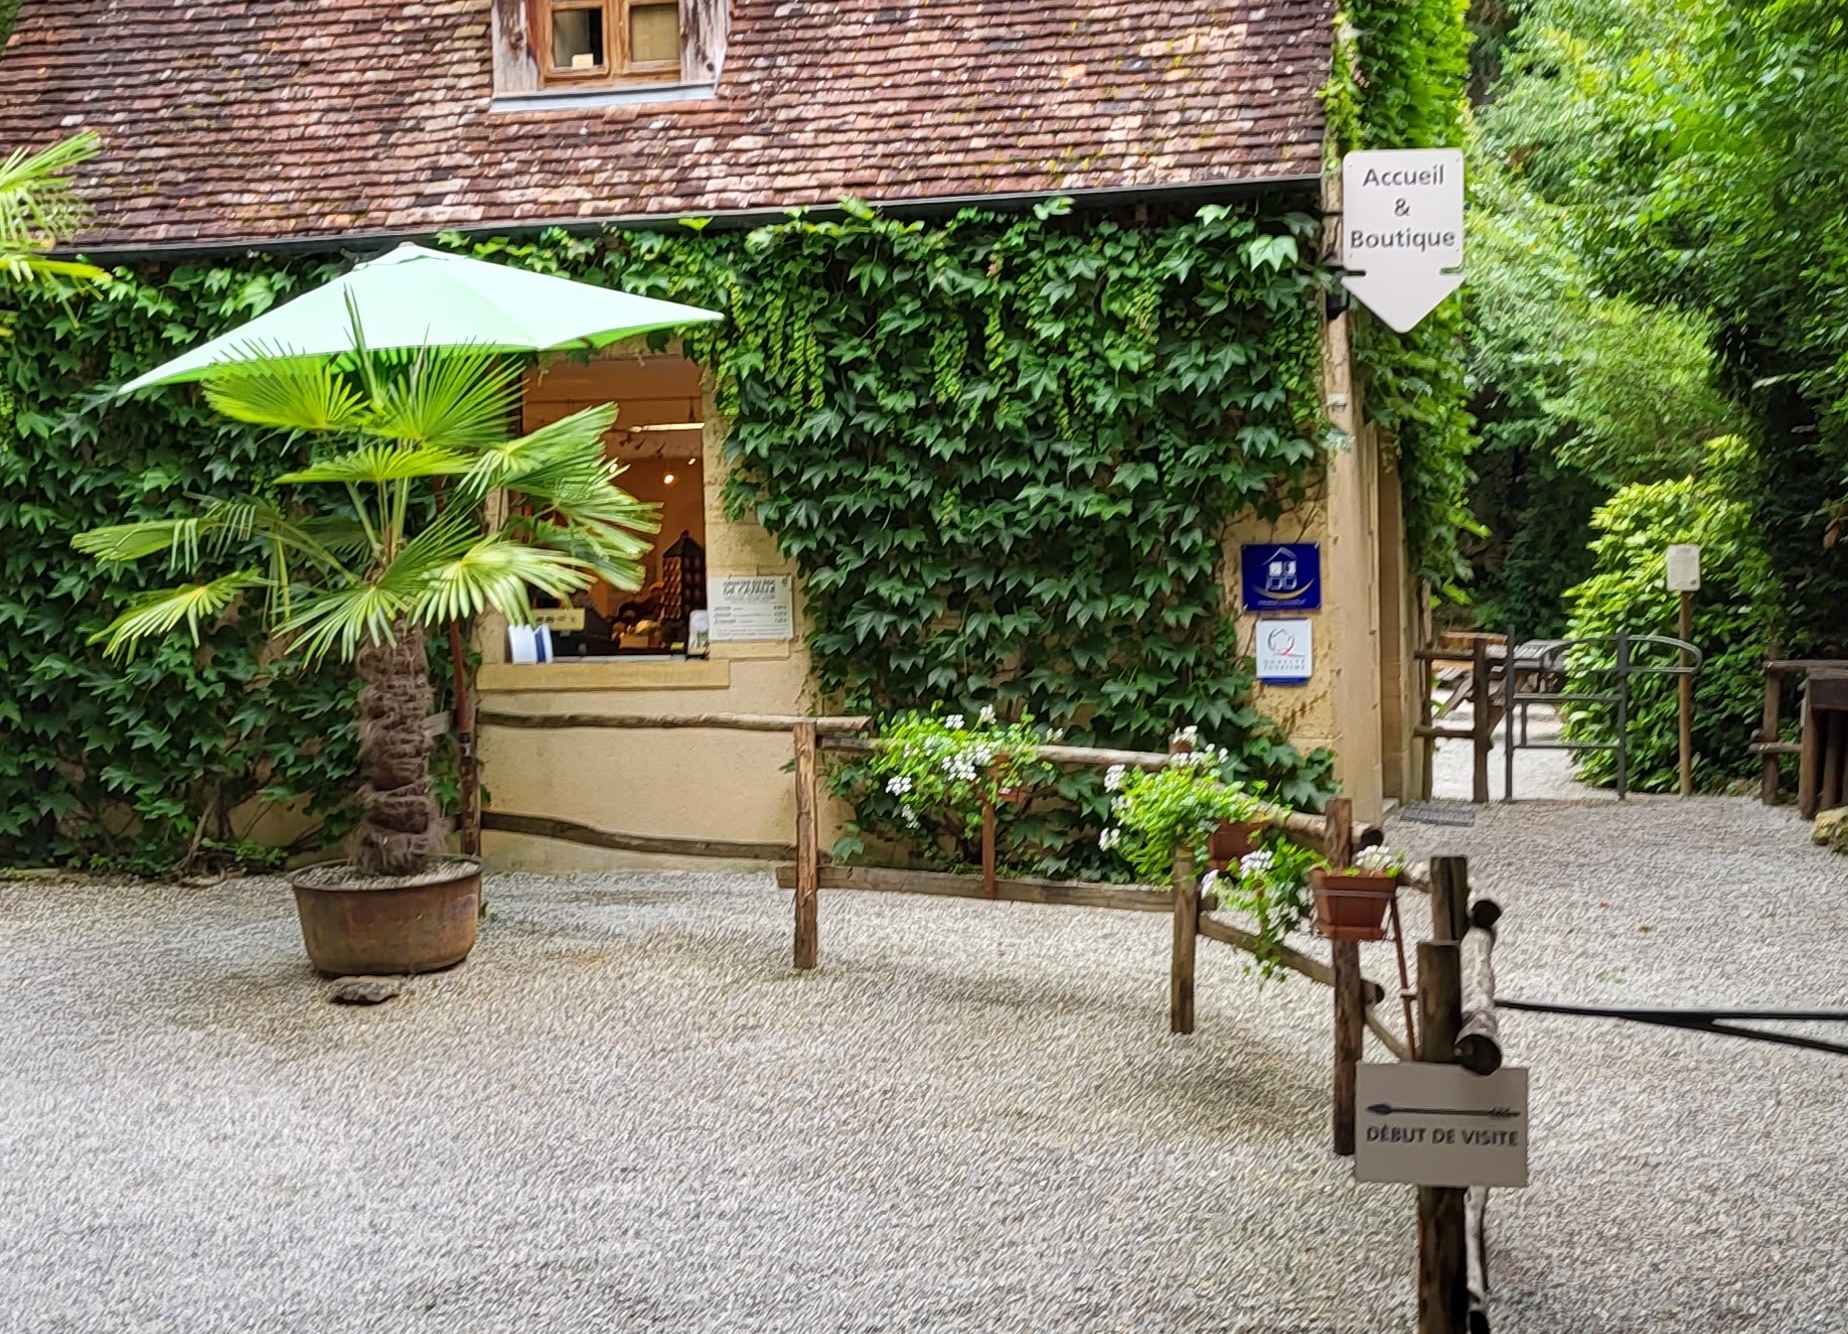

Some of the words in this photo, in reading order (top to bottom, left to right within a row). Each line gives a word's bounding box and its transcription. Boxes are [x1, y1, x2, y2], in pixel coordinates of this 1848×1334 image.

[1362, 164, 1445, 187] Accueil
[1393, 198, 1411, 217] &
[1350, 227, 1456, 252] Boutique
[1366, 1124, 1427, 1143] DÉBUT
[1431, 1128, 1457, 1144] DE
[1461, 1130, 1519, 1147] VISITE
